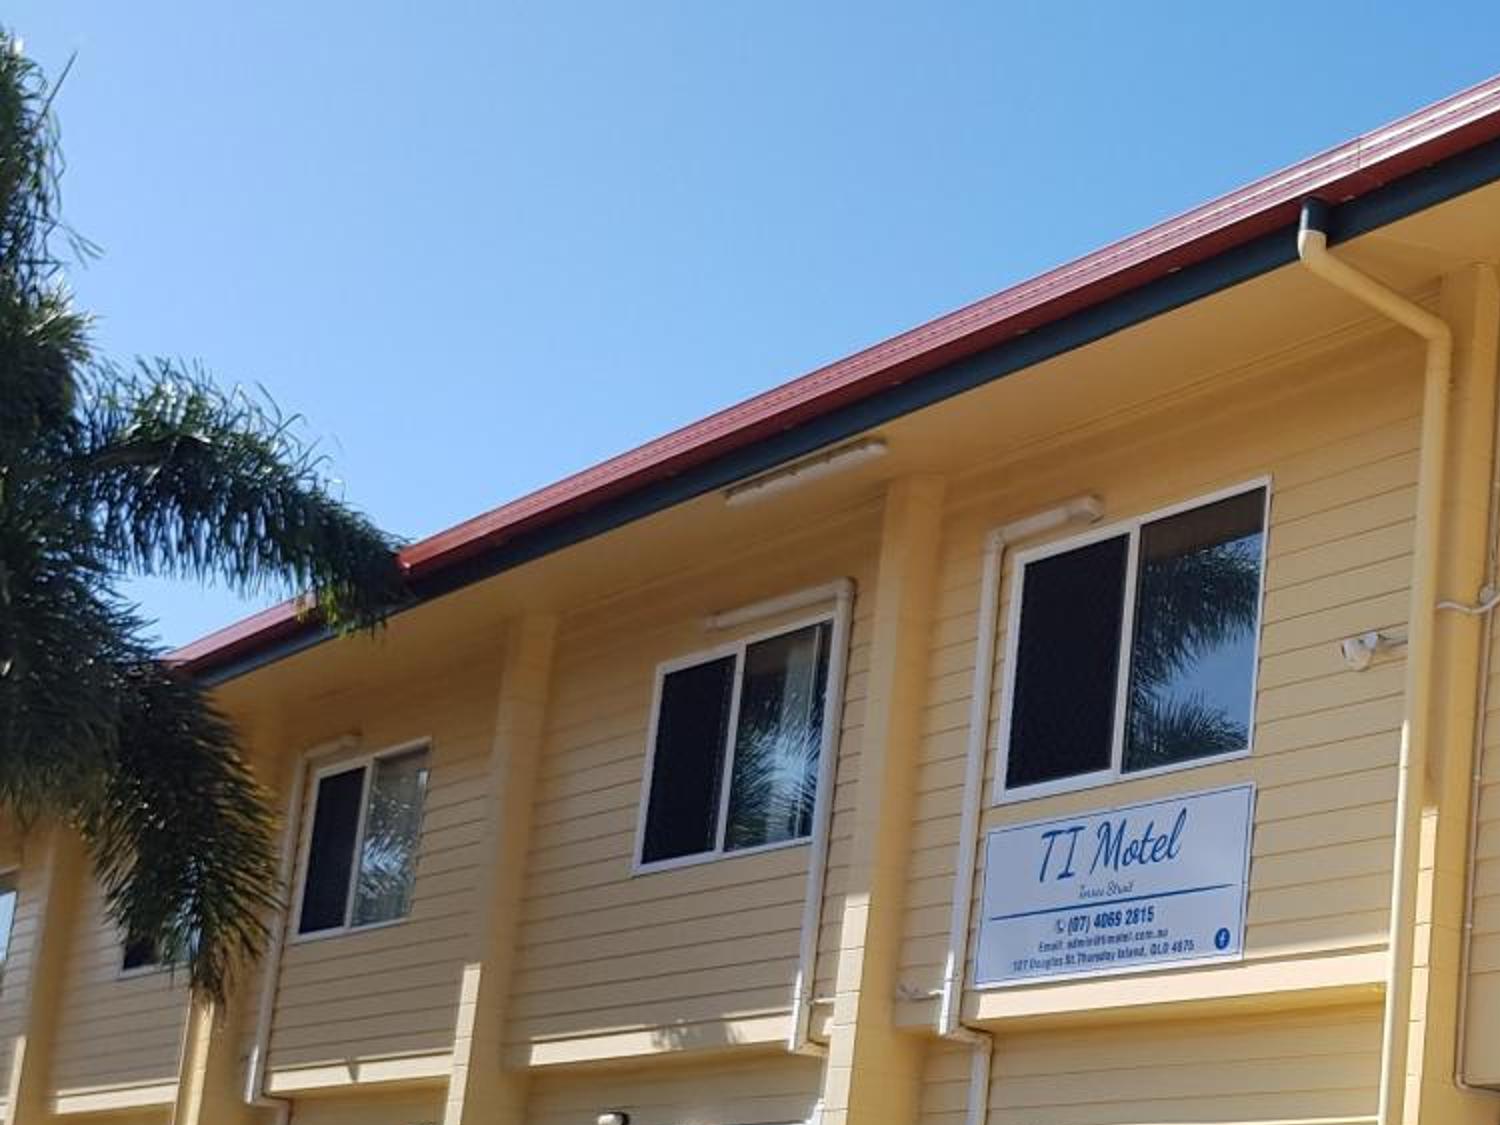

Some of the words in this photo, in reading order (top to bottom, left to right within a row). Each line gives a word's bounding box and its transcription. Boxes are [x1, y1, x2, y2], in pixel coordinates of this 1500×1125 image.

[1038, 825, 1086, 883] TI
[1090, 807, 1187, 875] Motel
[1067, 914, 1091, 936] (07)
[1094, 910, 1122, 929] 4069
